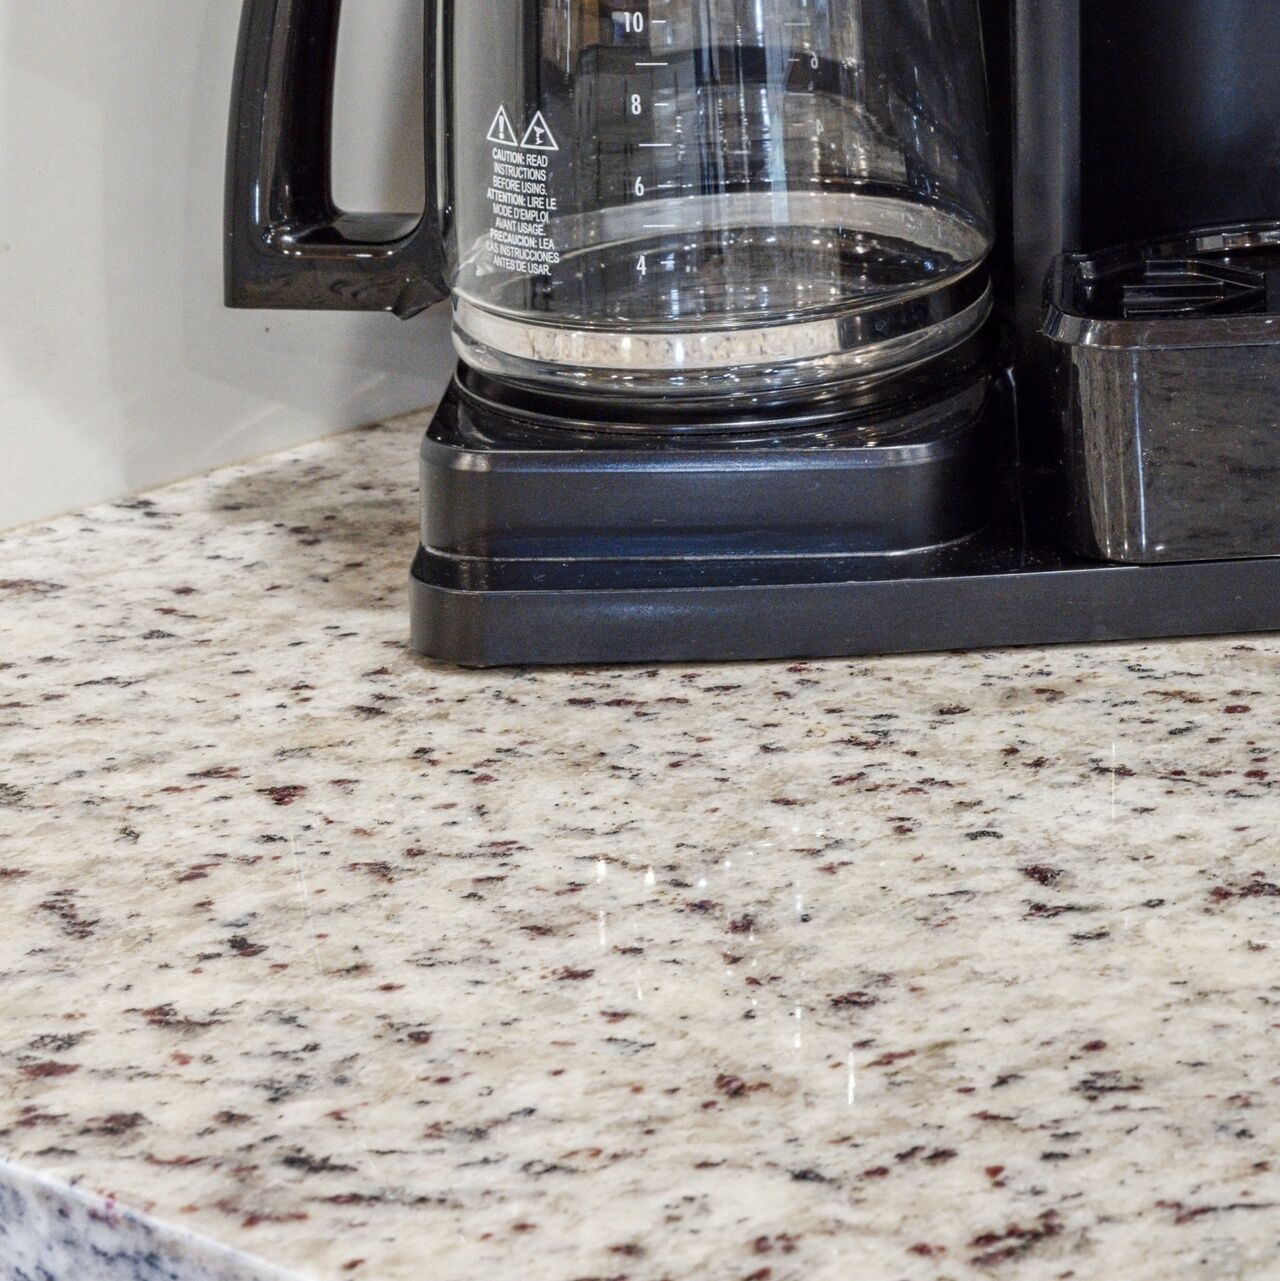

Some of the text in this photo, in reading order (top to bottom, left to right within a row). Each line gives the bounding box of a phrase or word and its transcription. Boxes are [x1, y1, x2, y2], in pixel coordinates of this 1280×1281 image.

[623, 11, 644, 33] 10
[630, 94, 642, 115] 8
[492, 147, 548, 167] CAUTION: READ
[493, 162, 547, 181] INSTRUCTIONS
[493, 175, 548, 195] BEFORE USING.
[634, 176, 645, 197] 6
[487, 187, 557, 210] ATTENTION: LIRE LE
[492, 203, 550, 224] MODE D'EMPLOI
[495, 217, 547, 236] AVANT USAGE.
[489, 228, 555, 250] PRECAUCION: LEA
[486, 239, 560, 264] LAS INSTRUCCIONES
[493, 256, 552, 276] ANTES DE USAR.
[636, 255, 647, 276] 4
